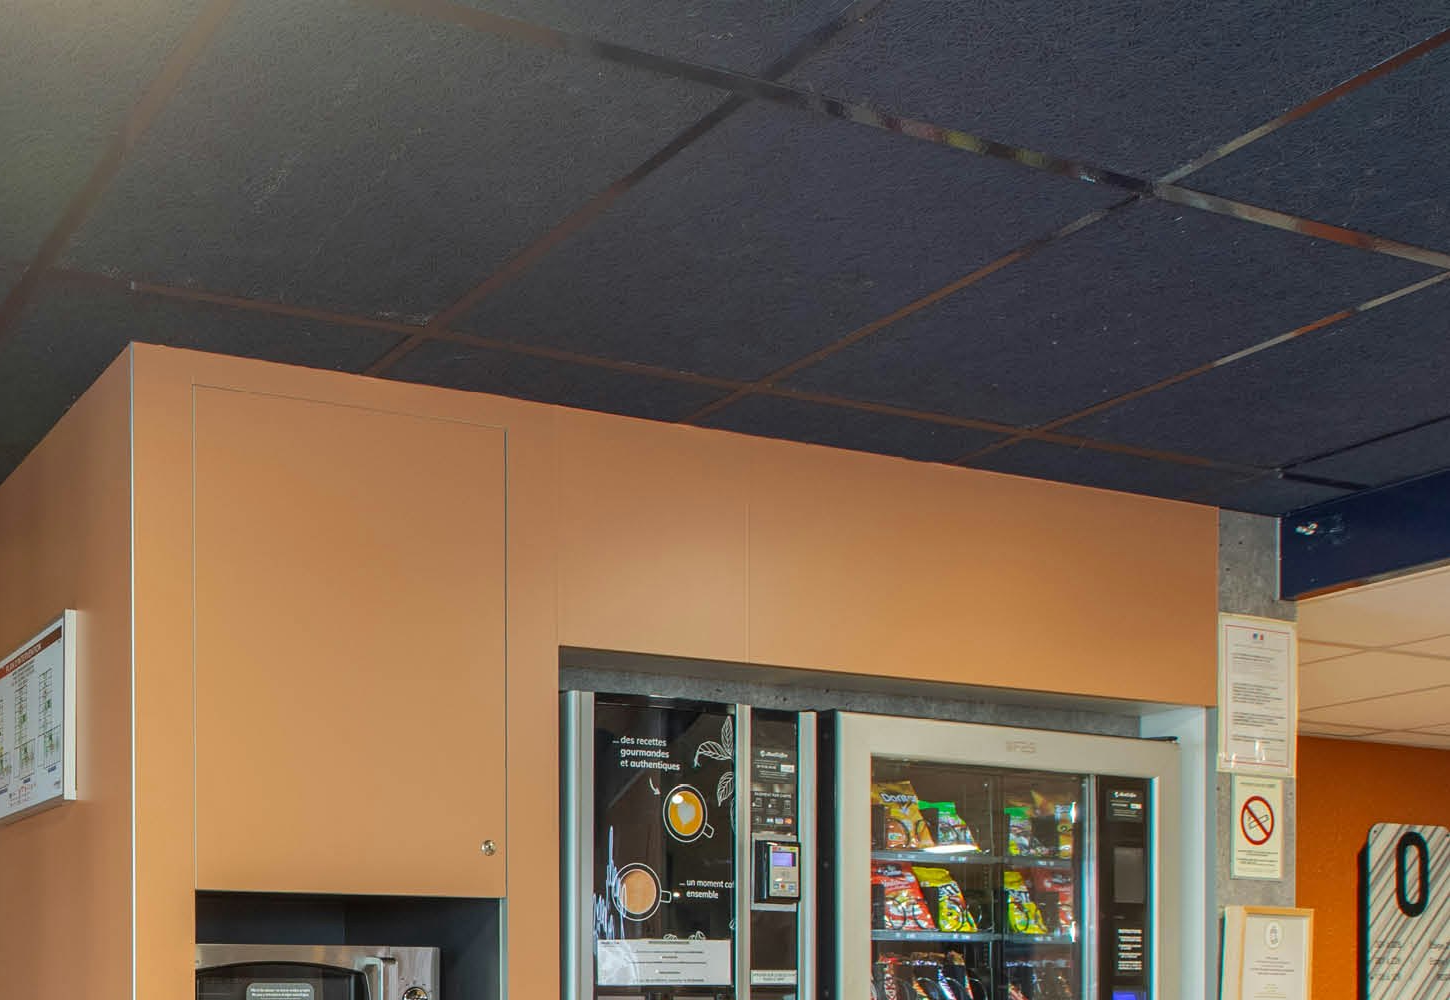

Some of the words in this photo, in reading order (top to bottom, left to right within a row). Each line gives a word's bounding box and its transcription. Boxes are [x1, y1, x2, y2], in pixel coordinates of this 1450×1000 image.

[636, 737, 667, 747] recettes
[620, 748, 669, 759] gourmandes
[630, 760, 681, 772] authentiques
[697, 880, 723, 889] moment
[686, 890, 719, 899] ensemble
